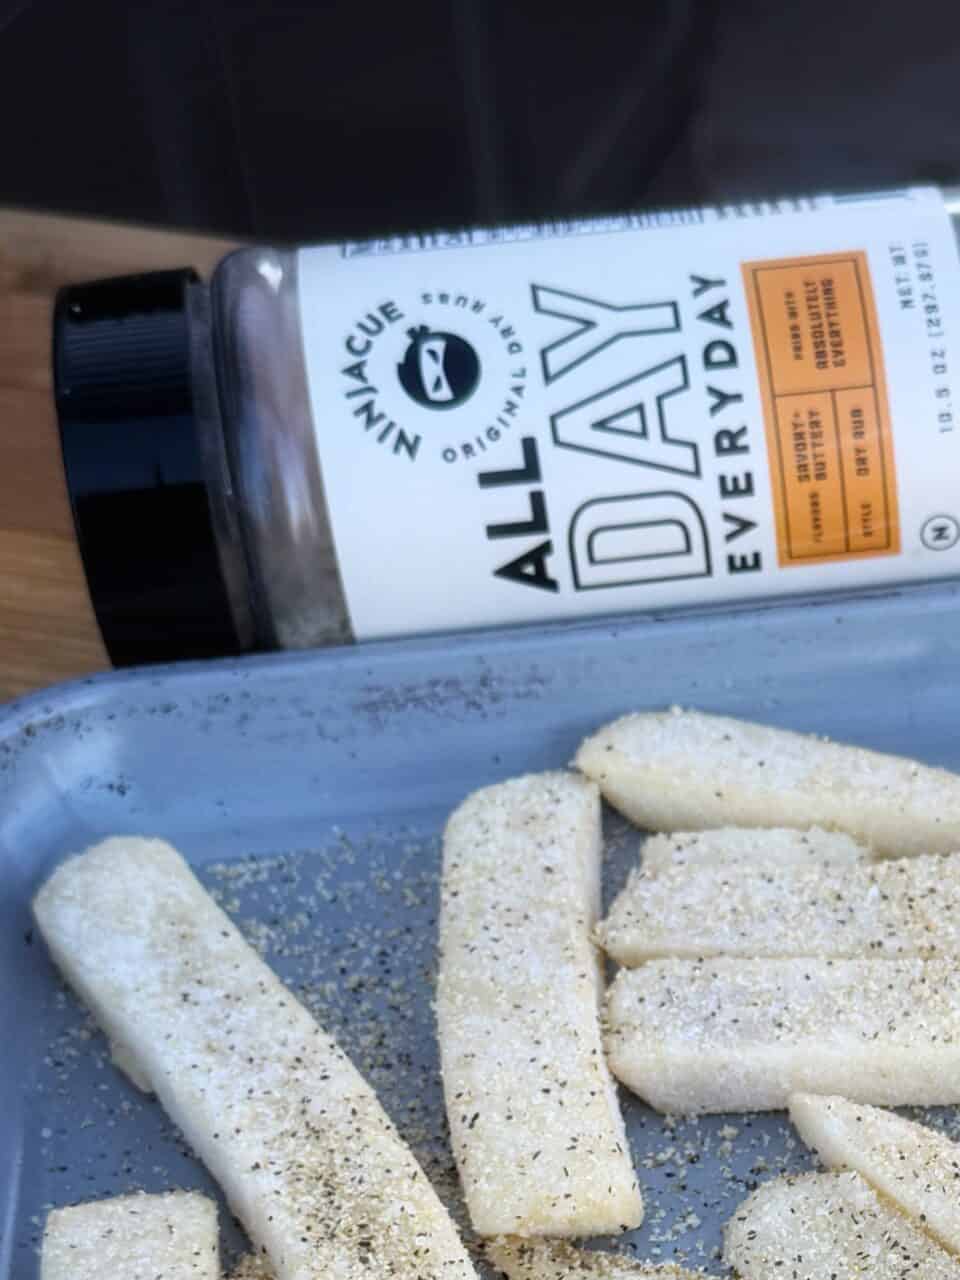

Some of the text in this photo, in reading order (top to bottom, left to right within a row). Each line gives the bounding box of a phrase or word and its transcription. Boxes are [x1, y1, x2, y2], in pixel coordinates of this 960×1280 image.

[803, 281, 829, 369] ABSOLUTELY
[821, 278, 846, 368] EVERYTHING
[896, 274, 915, 310] NET
[342, 300, 422, 462] NINJACUE
[421, 291, 528, 464] ORIGINAL DRY RUBS
[935, 387, 953, 433] 10.5
[530, 282, 713, 592] DAY
[689, 273, 762, 575] EVERYDAY
[808, 409, 826, 481] BUTTERY
[850, 408, 870, 476] DRY RUB
[477, 436, 560, 593] ALL
